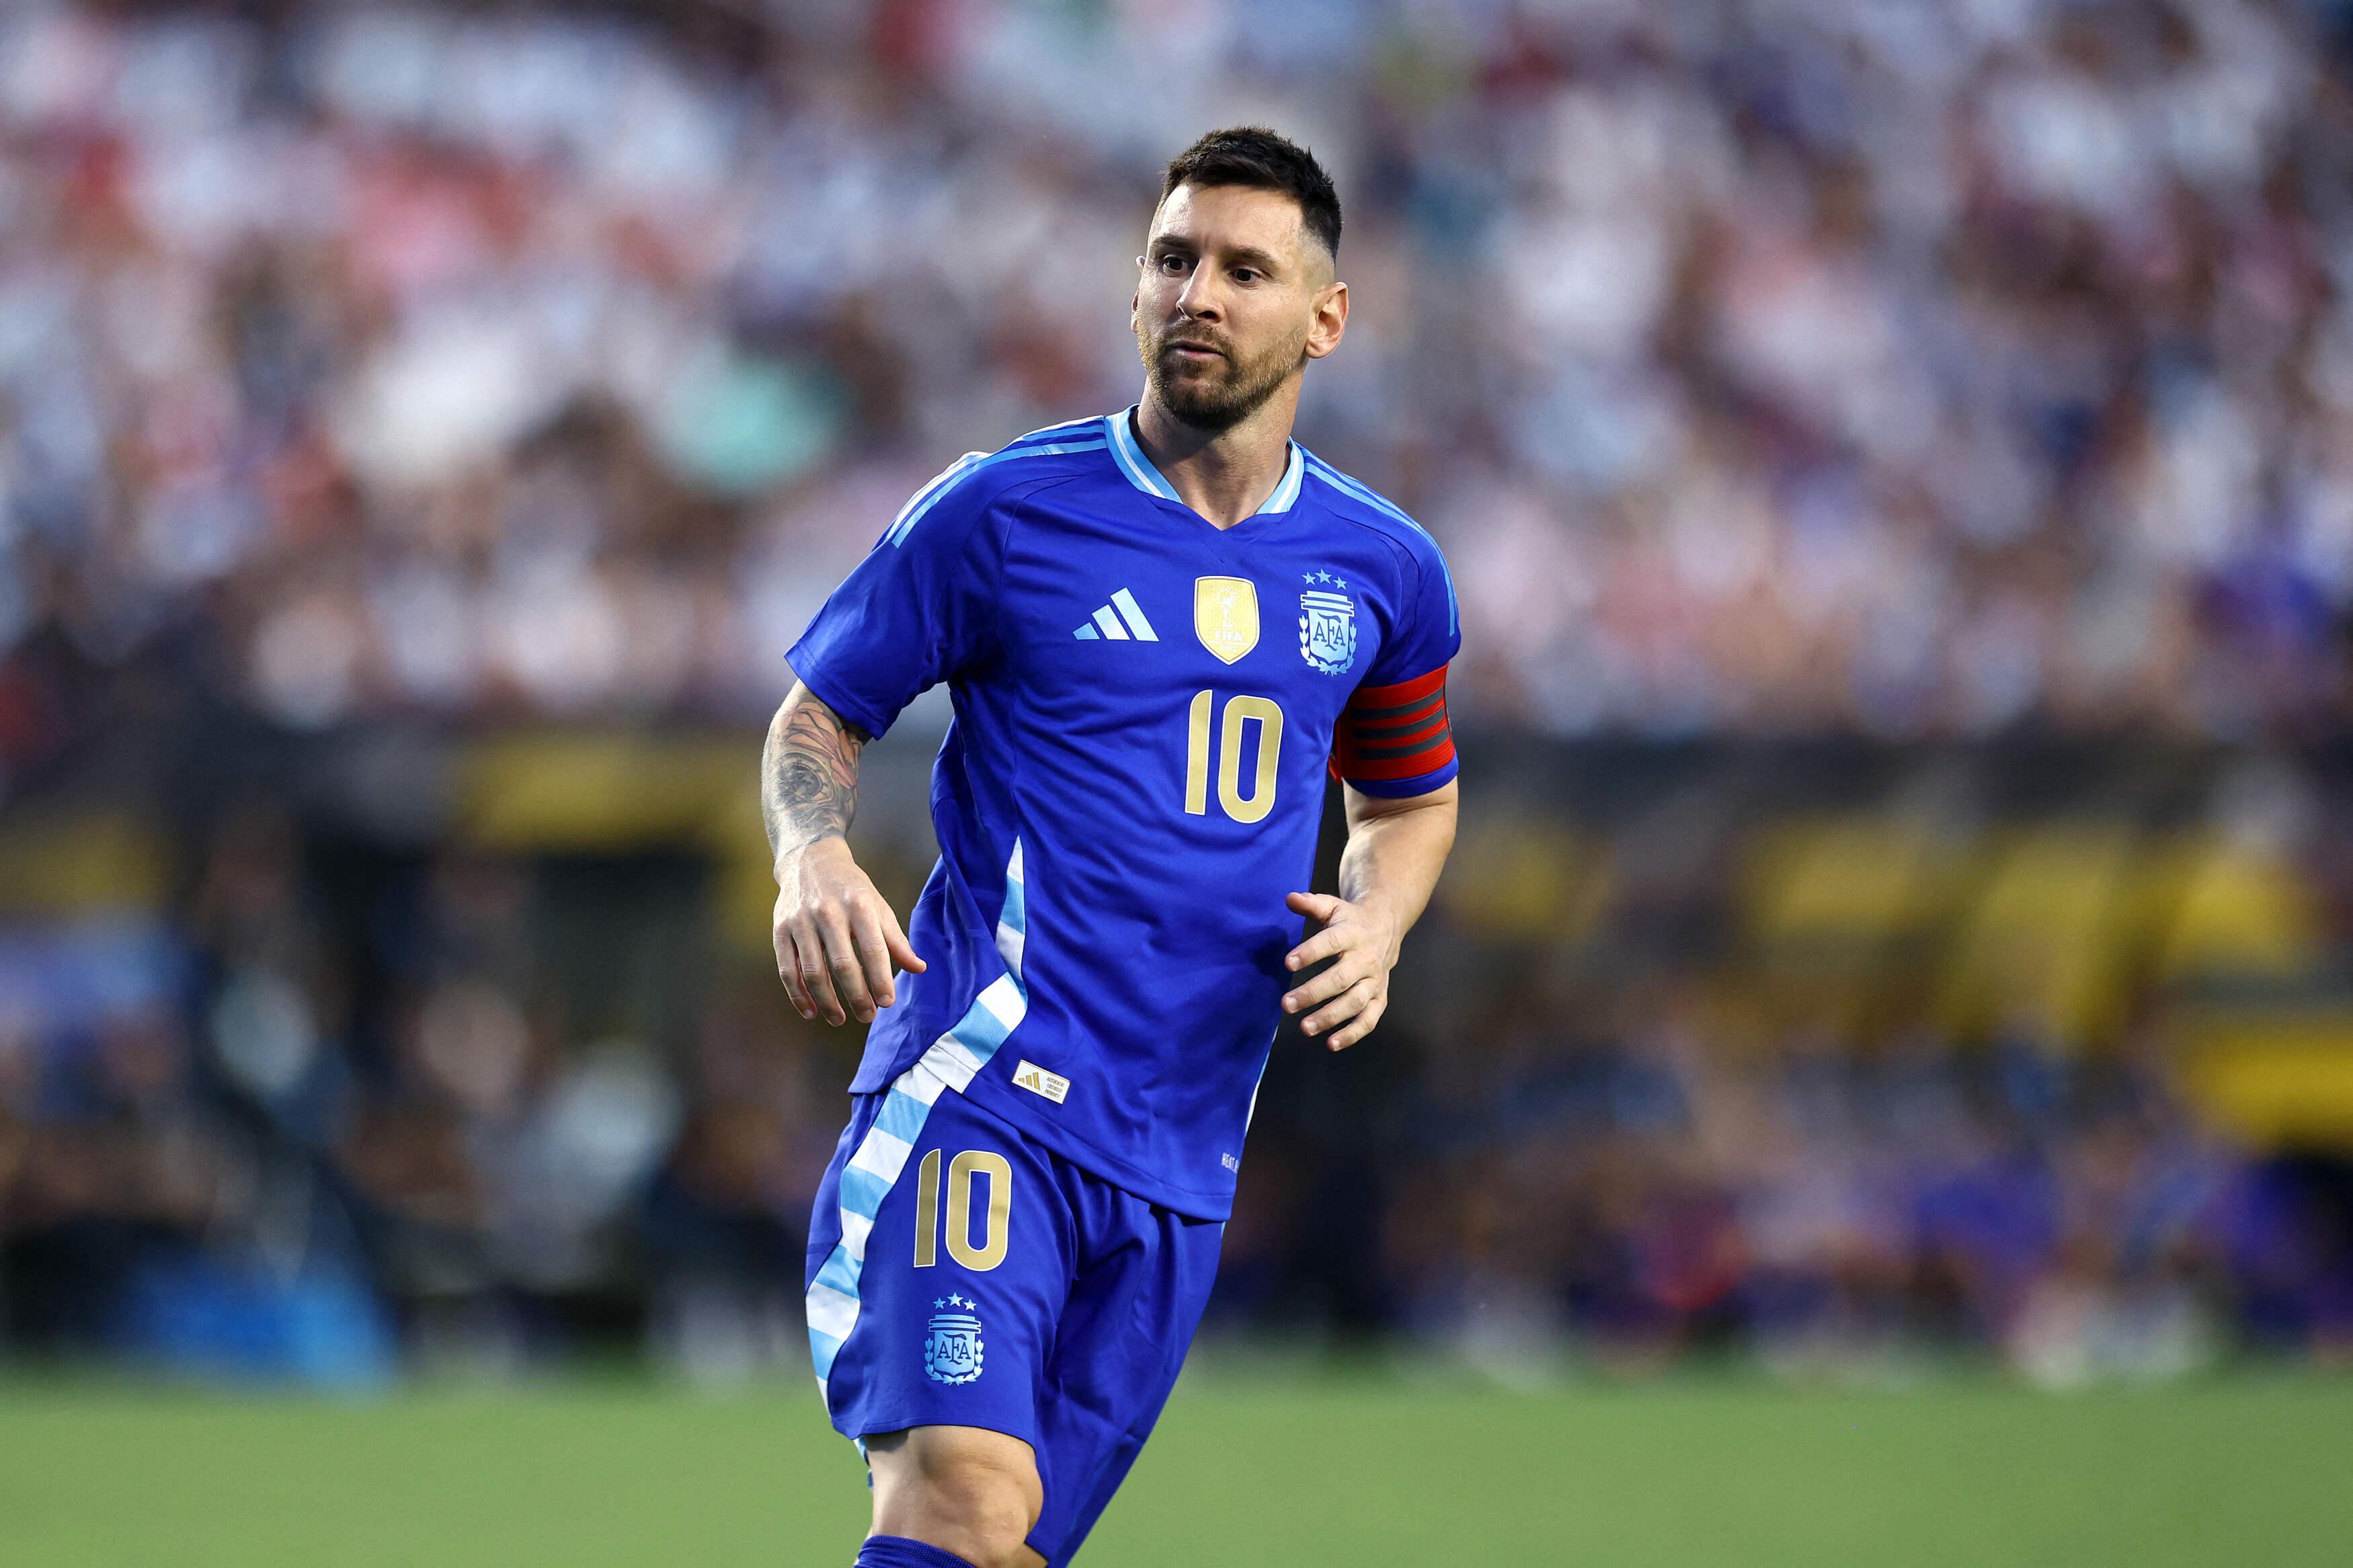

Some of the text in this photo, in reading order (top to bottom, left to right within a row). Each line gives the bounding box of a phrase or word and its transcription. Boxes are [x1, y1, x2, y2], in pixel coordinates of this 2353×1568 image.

[1215, 630, 1242, 641] FIFA
[1313, 612, 1345, 651] AFA
[1185, 689, 1284, 824] 10
[913, 1148, 1012, 1272] 10
[936, 1333, 971, 1364] AFA
